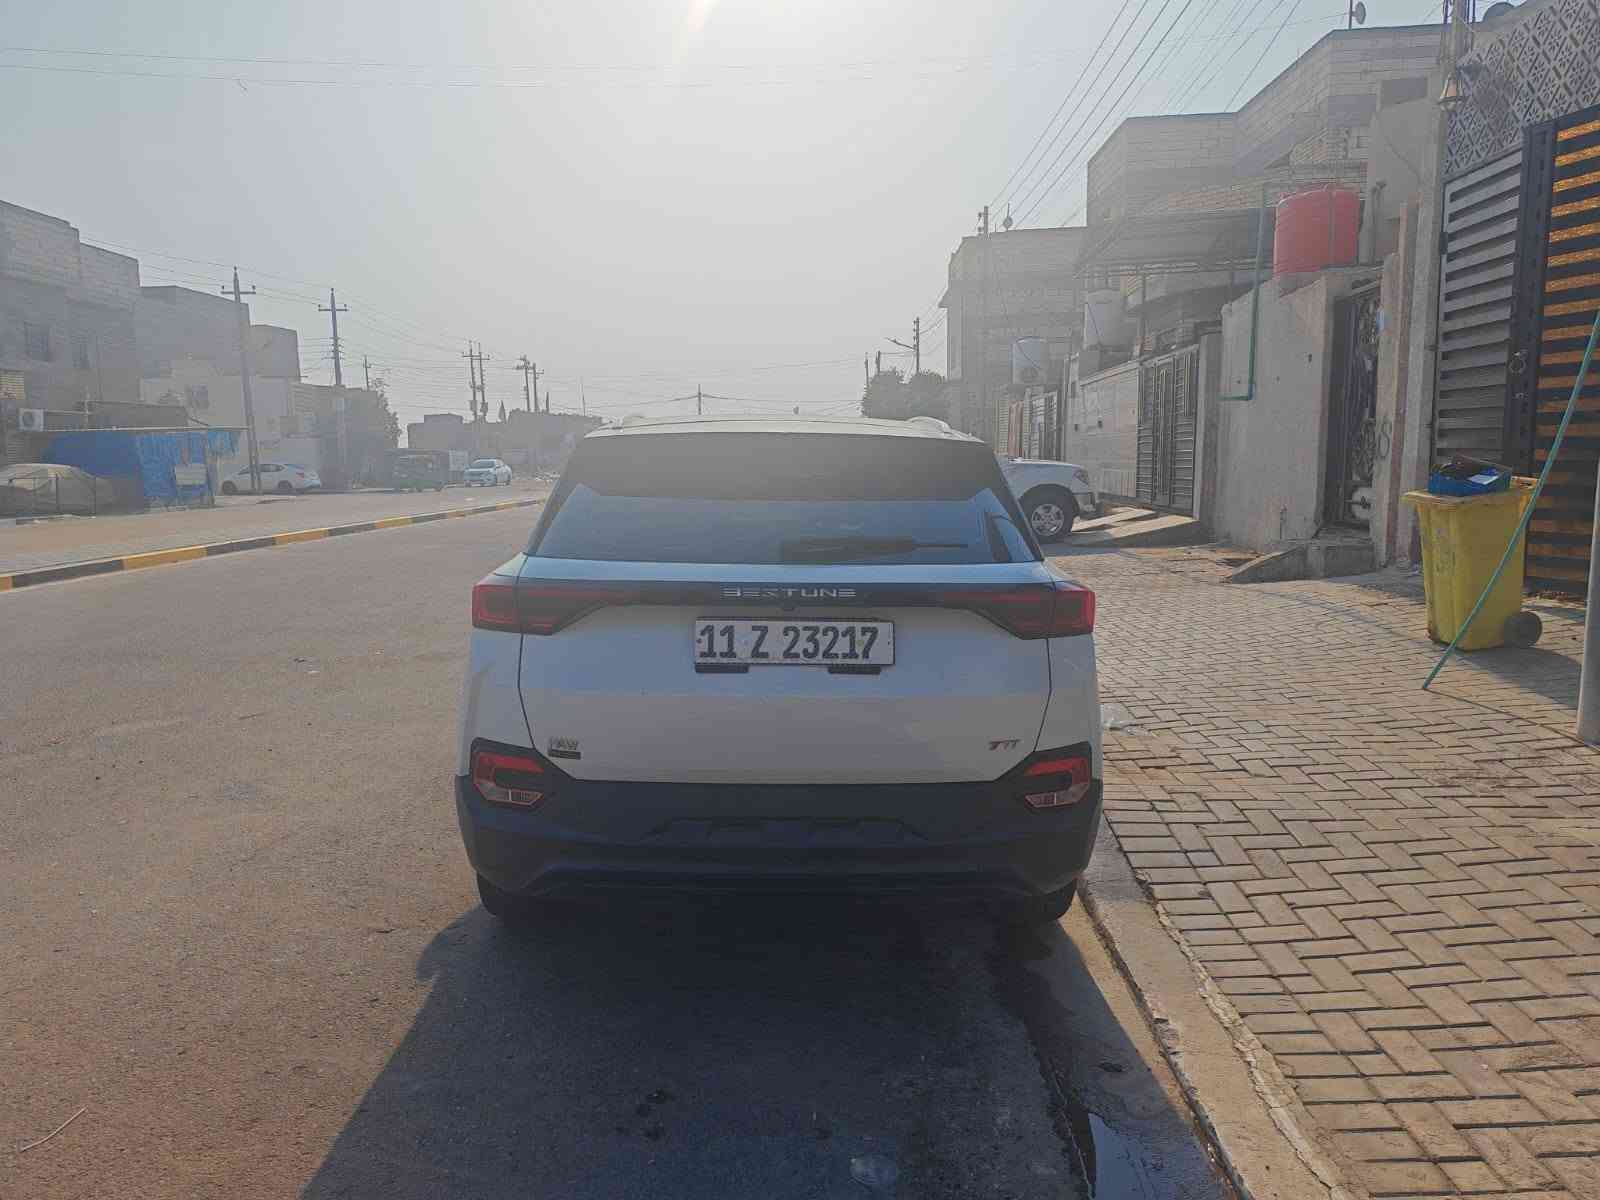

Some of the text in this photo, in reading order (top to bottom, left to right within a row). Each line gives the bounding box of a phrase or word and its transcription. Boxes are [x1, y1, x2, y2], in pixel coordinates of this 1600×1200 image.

[722, 587, 856, 597] BESTUNE
[699, 625, 879, 660] 11 Z 23217
